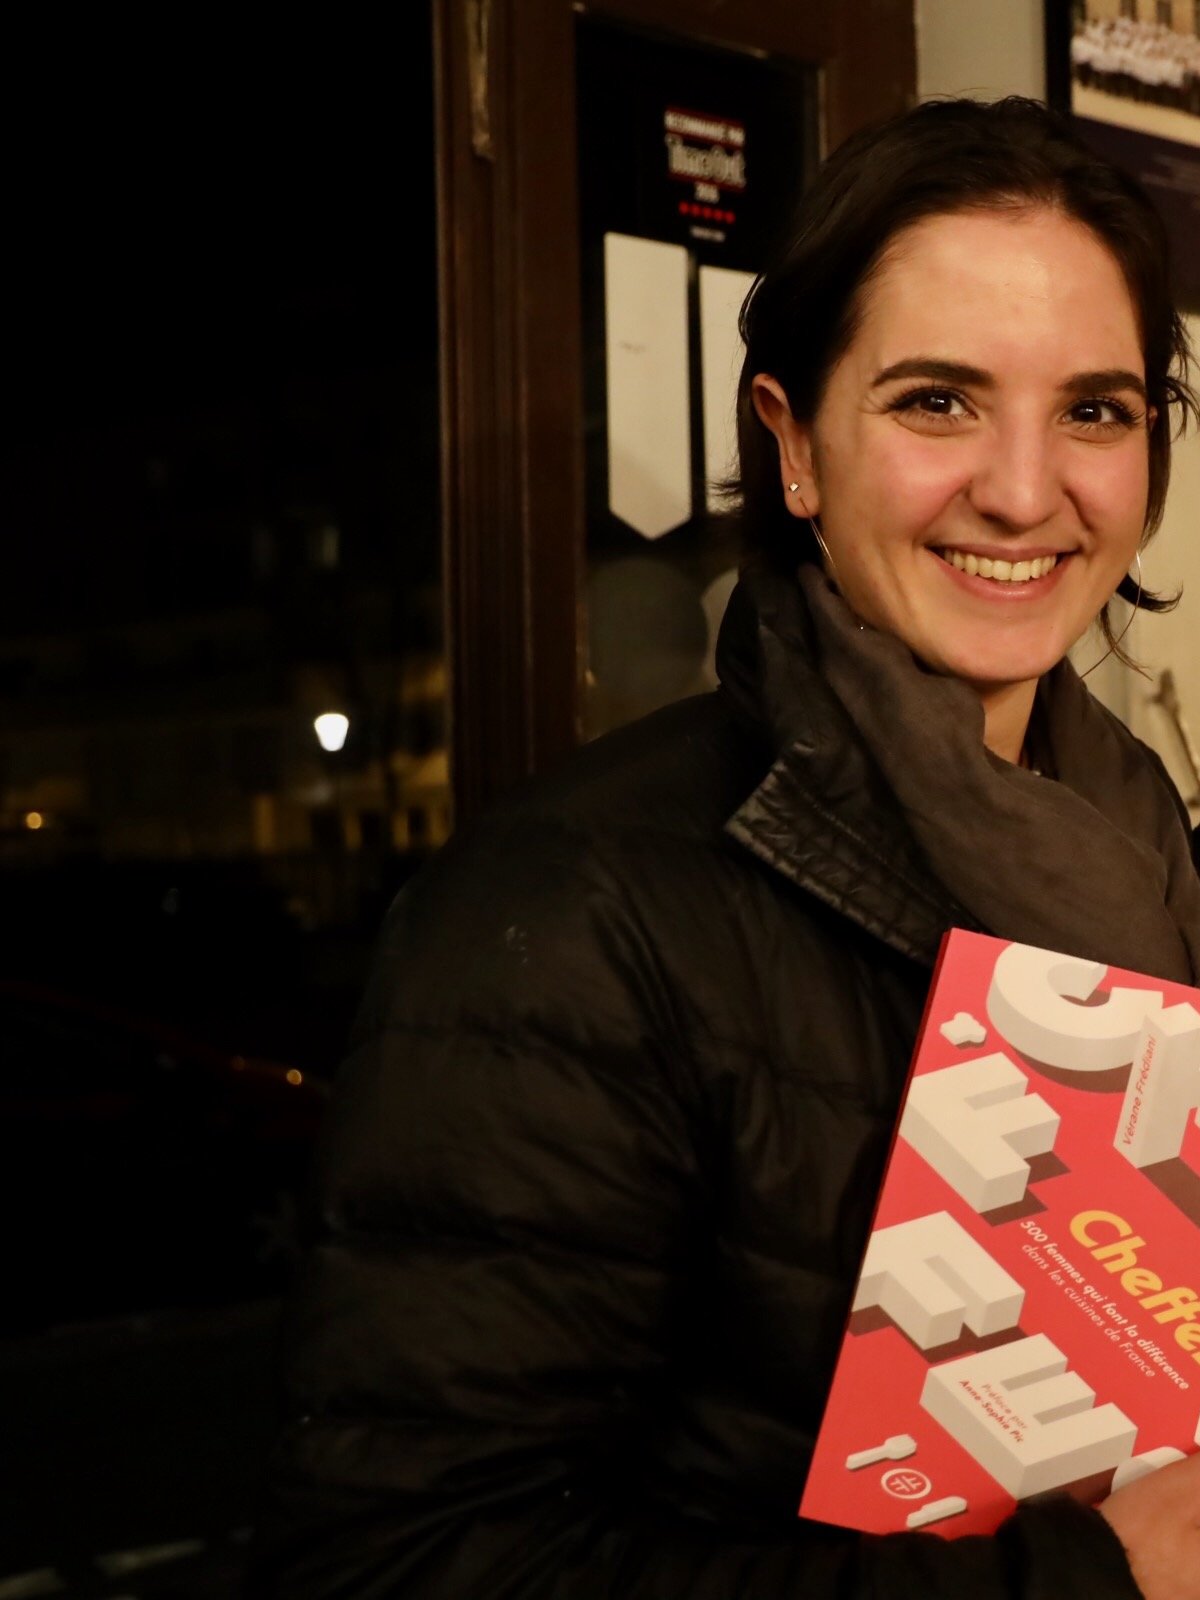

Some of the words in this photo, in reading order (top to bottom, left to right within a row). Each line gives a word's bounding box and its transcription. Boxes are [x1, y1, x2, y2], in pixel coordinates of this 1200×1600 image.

[1122, 1097, 1142, 1145] Vérane
[1135, 1036, 1157, 1095] Frédiani
[1020, 1220, 1048, 1242] 500
[1043, 1243, 1086, 1284] femmes
[1083, 1285, 1108, 1303] qui
[1102, 1302, 1128, 1326] font
[1124, 1324, 1139, 1338] la
[1136, 1338, 1189, 1390] différence
[1021, 1244, 1050, 1270] dans
[1048, 1270, 1065, 1286] les
[1064, 1287, 1105, 1327] cuisines
[1104, 1327, 1121, 1342] de
[1119, 1342, 1156, 1378] France
[958, 1379, 1010, 1430] Anne-Sophie
[1009, 1429, 1024, 1443] Pic
